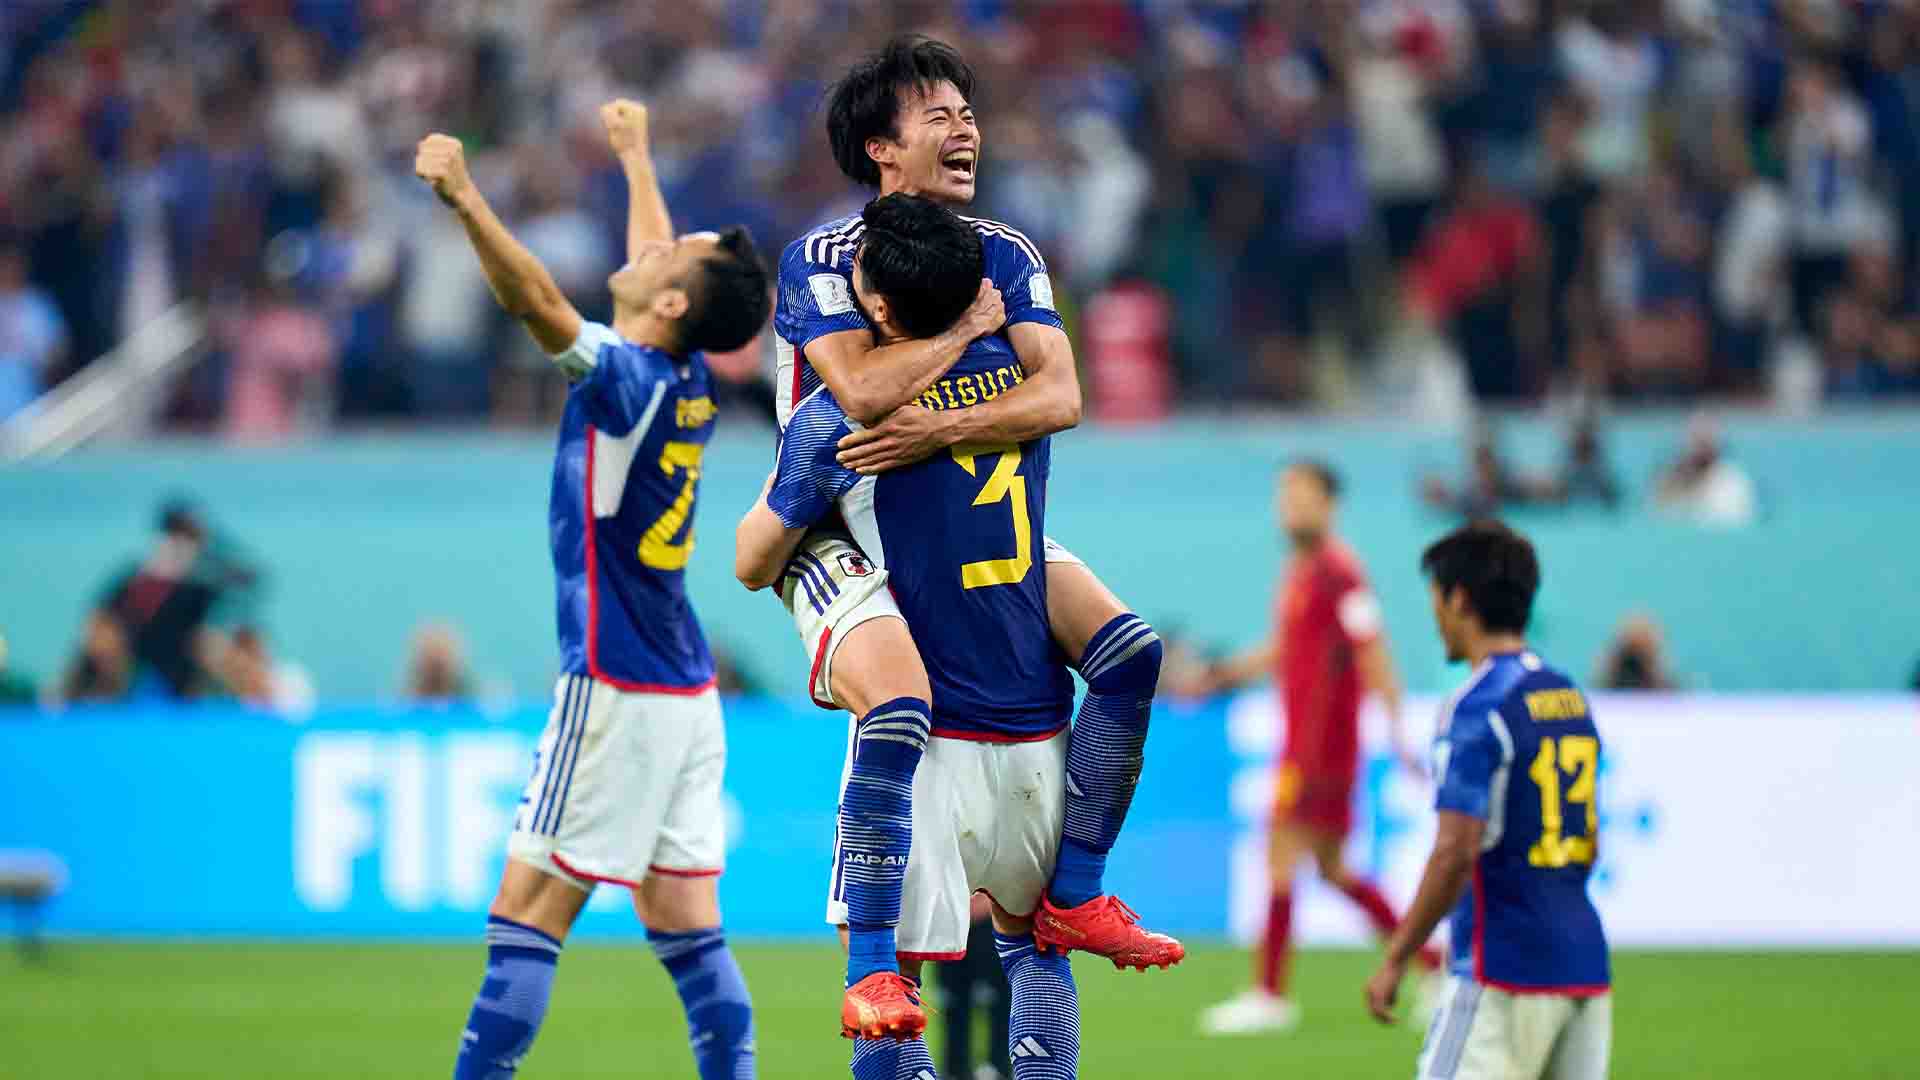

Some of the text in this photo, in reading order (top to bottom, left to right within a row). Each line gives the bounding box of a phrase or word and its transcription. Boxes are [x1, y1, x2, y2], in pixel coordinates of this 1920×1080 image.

[951, 446, 1032, 590] 3
[293, 730, 743, 912] FIF
[845, 852, 906, 866] JAPAN
[1528, 735, 1600, 868] 13
